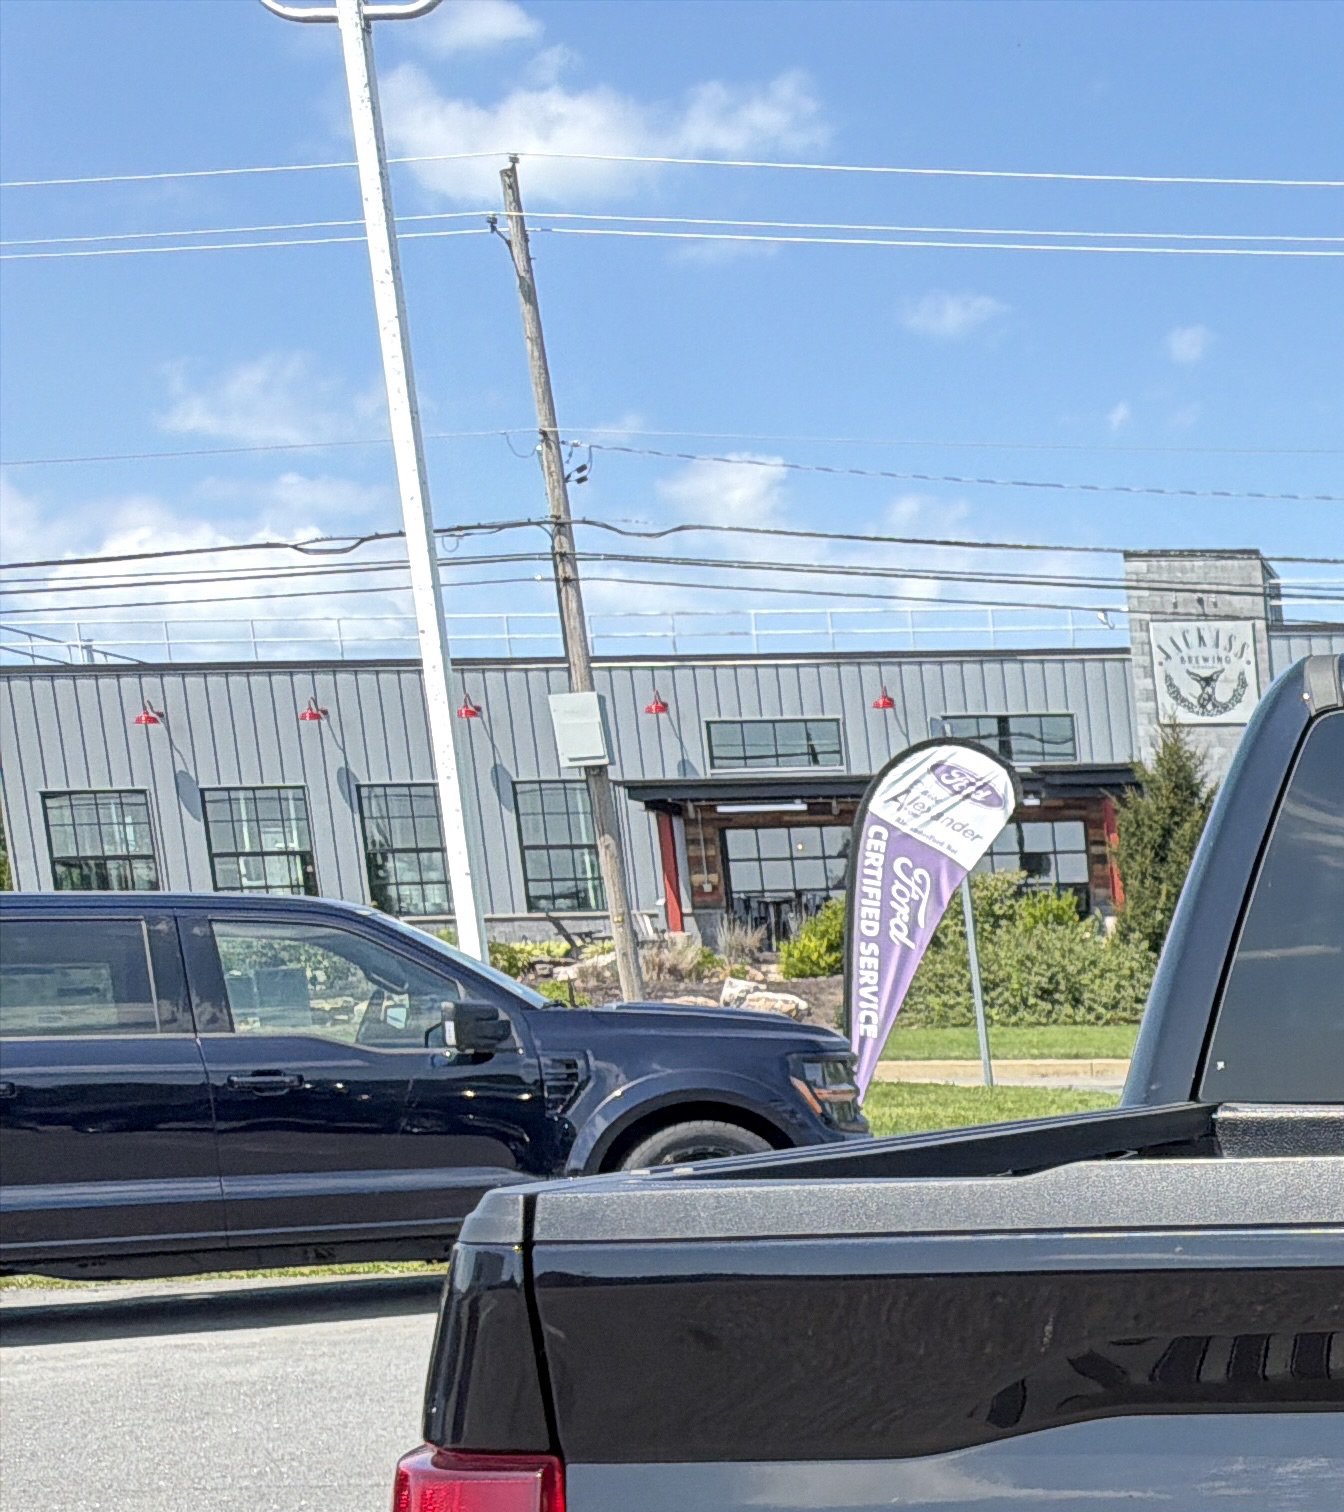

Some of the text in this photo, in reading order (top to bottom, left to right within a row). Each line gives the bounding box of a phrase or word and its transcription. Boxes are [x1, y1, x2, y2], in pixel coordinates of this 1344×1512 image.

[1180, 655, 1232, 665] BREWING
[883, 787, 984, 842] Alender
[858, 824, 888, 1039] CERTIFIED SERVICE
[889, 856, 931, 950] Ford
